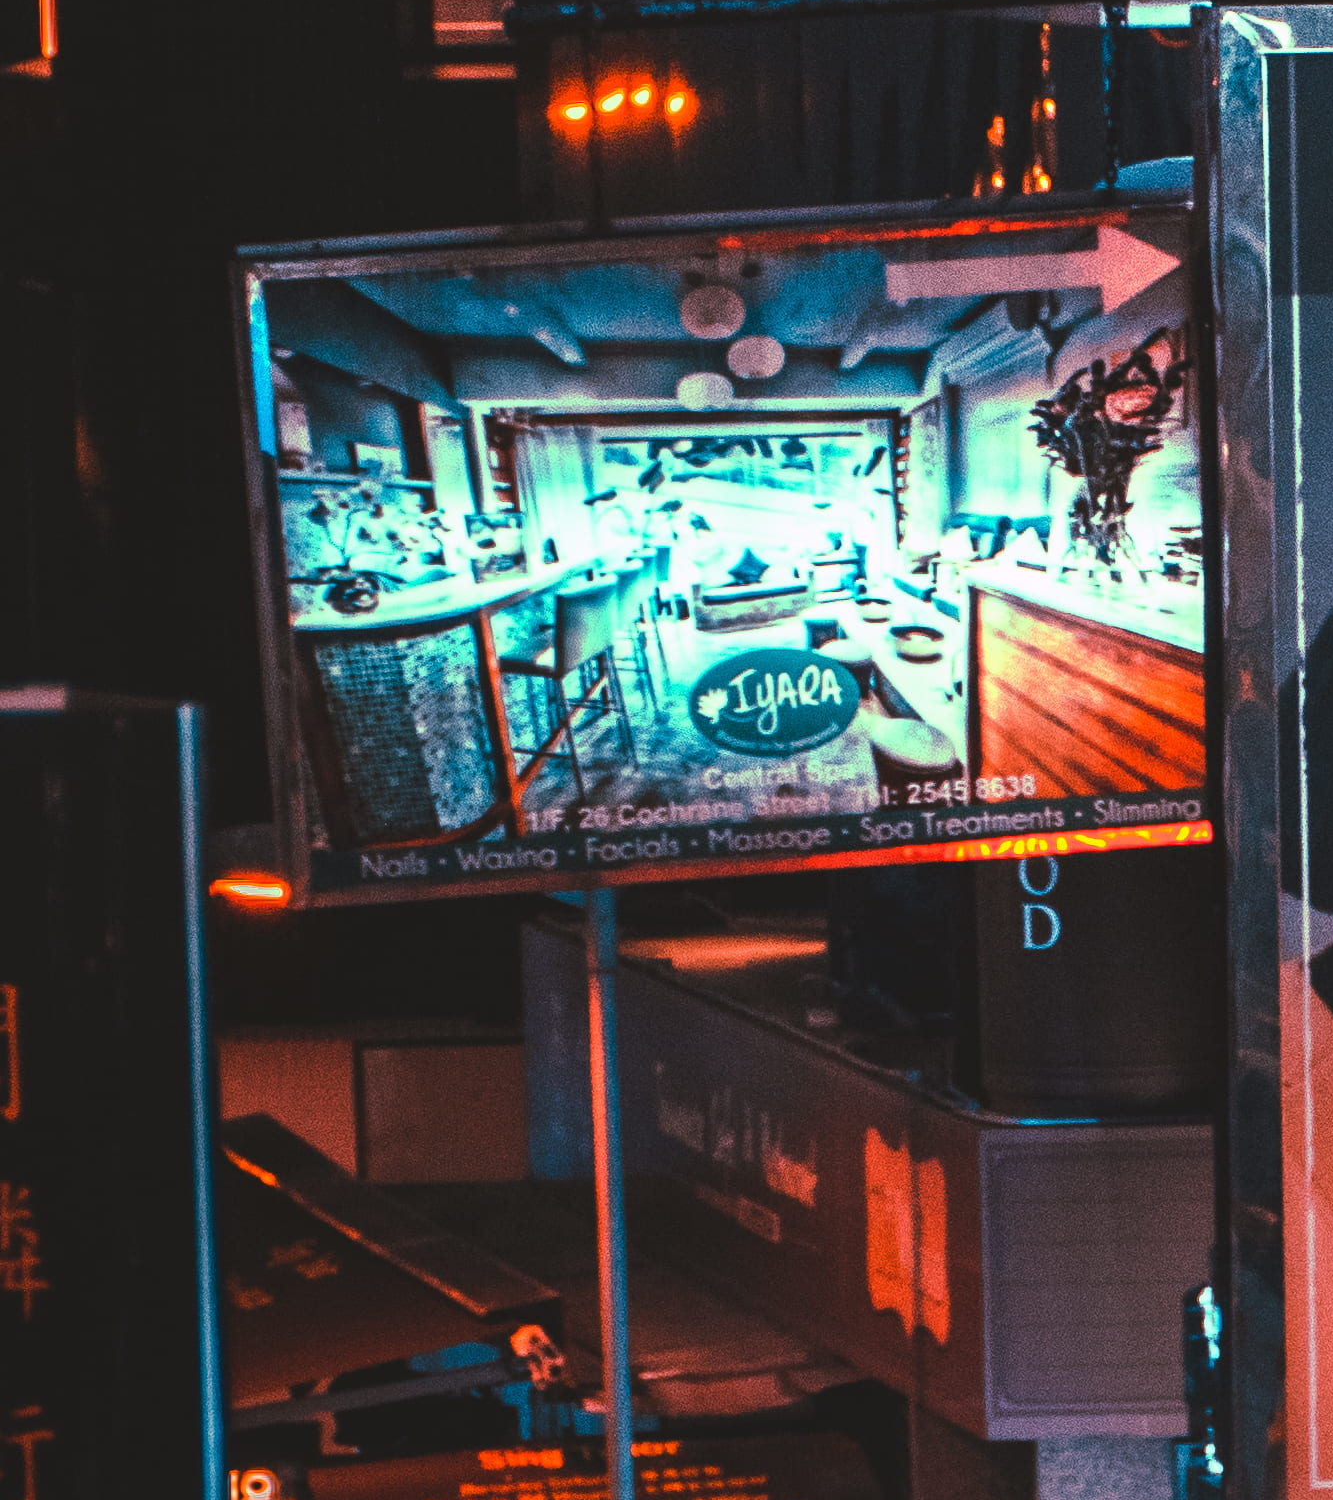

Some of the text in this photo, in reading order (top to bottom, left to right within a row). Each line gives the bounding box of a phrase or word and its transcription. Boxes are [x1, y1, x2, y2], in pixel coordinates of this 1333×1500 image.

[906, 779, 968, 805] 2545
[360, 795, 1202, 878] Nails Waxing Facials Massage Spa Treatments Slimming
